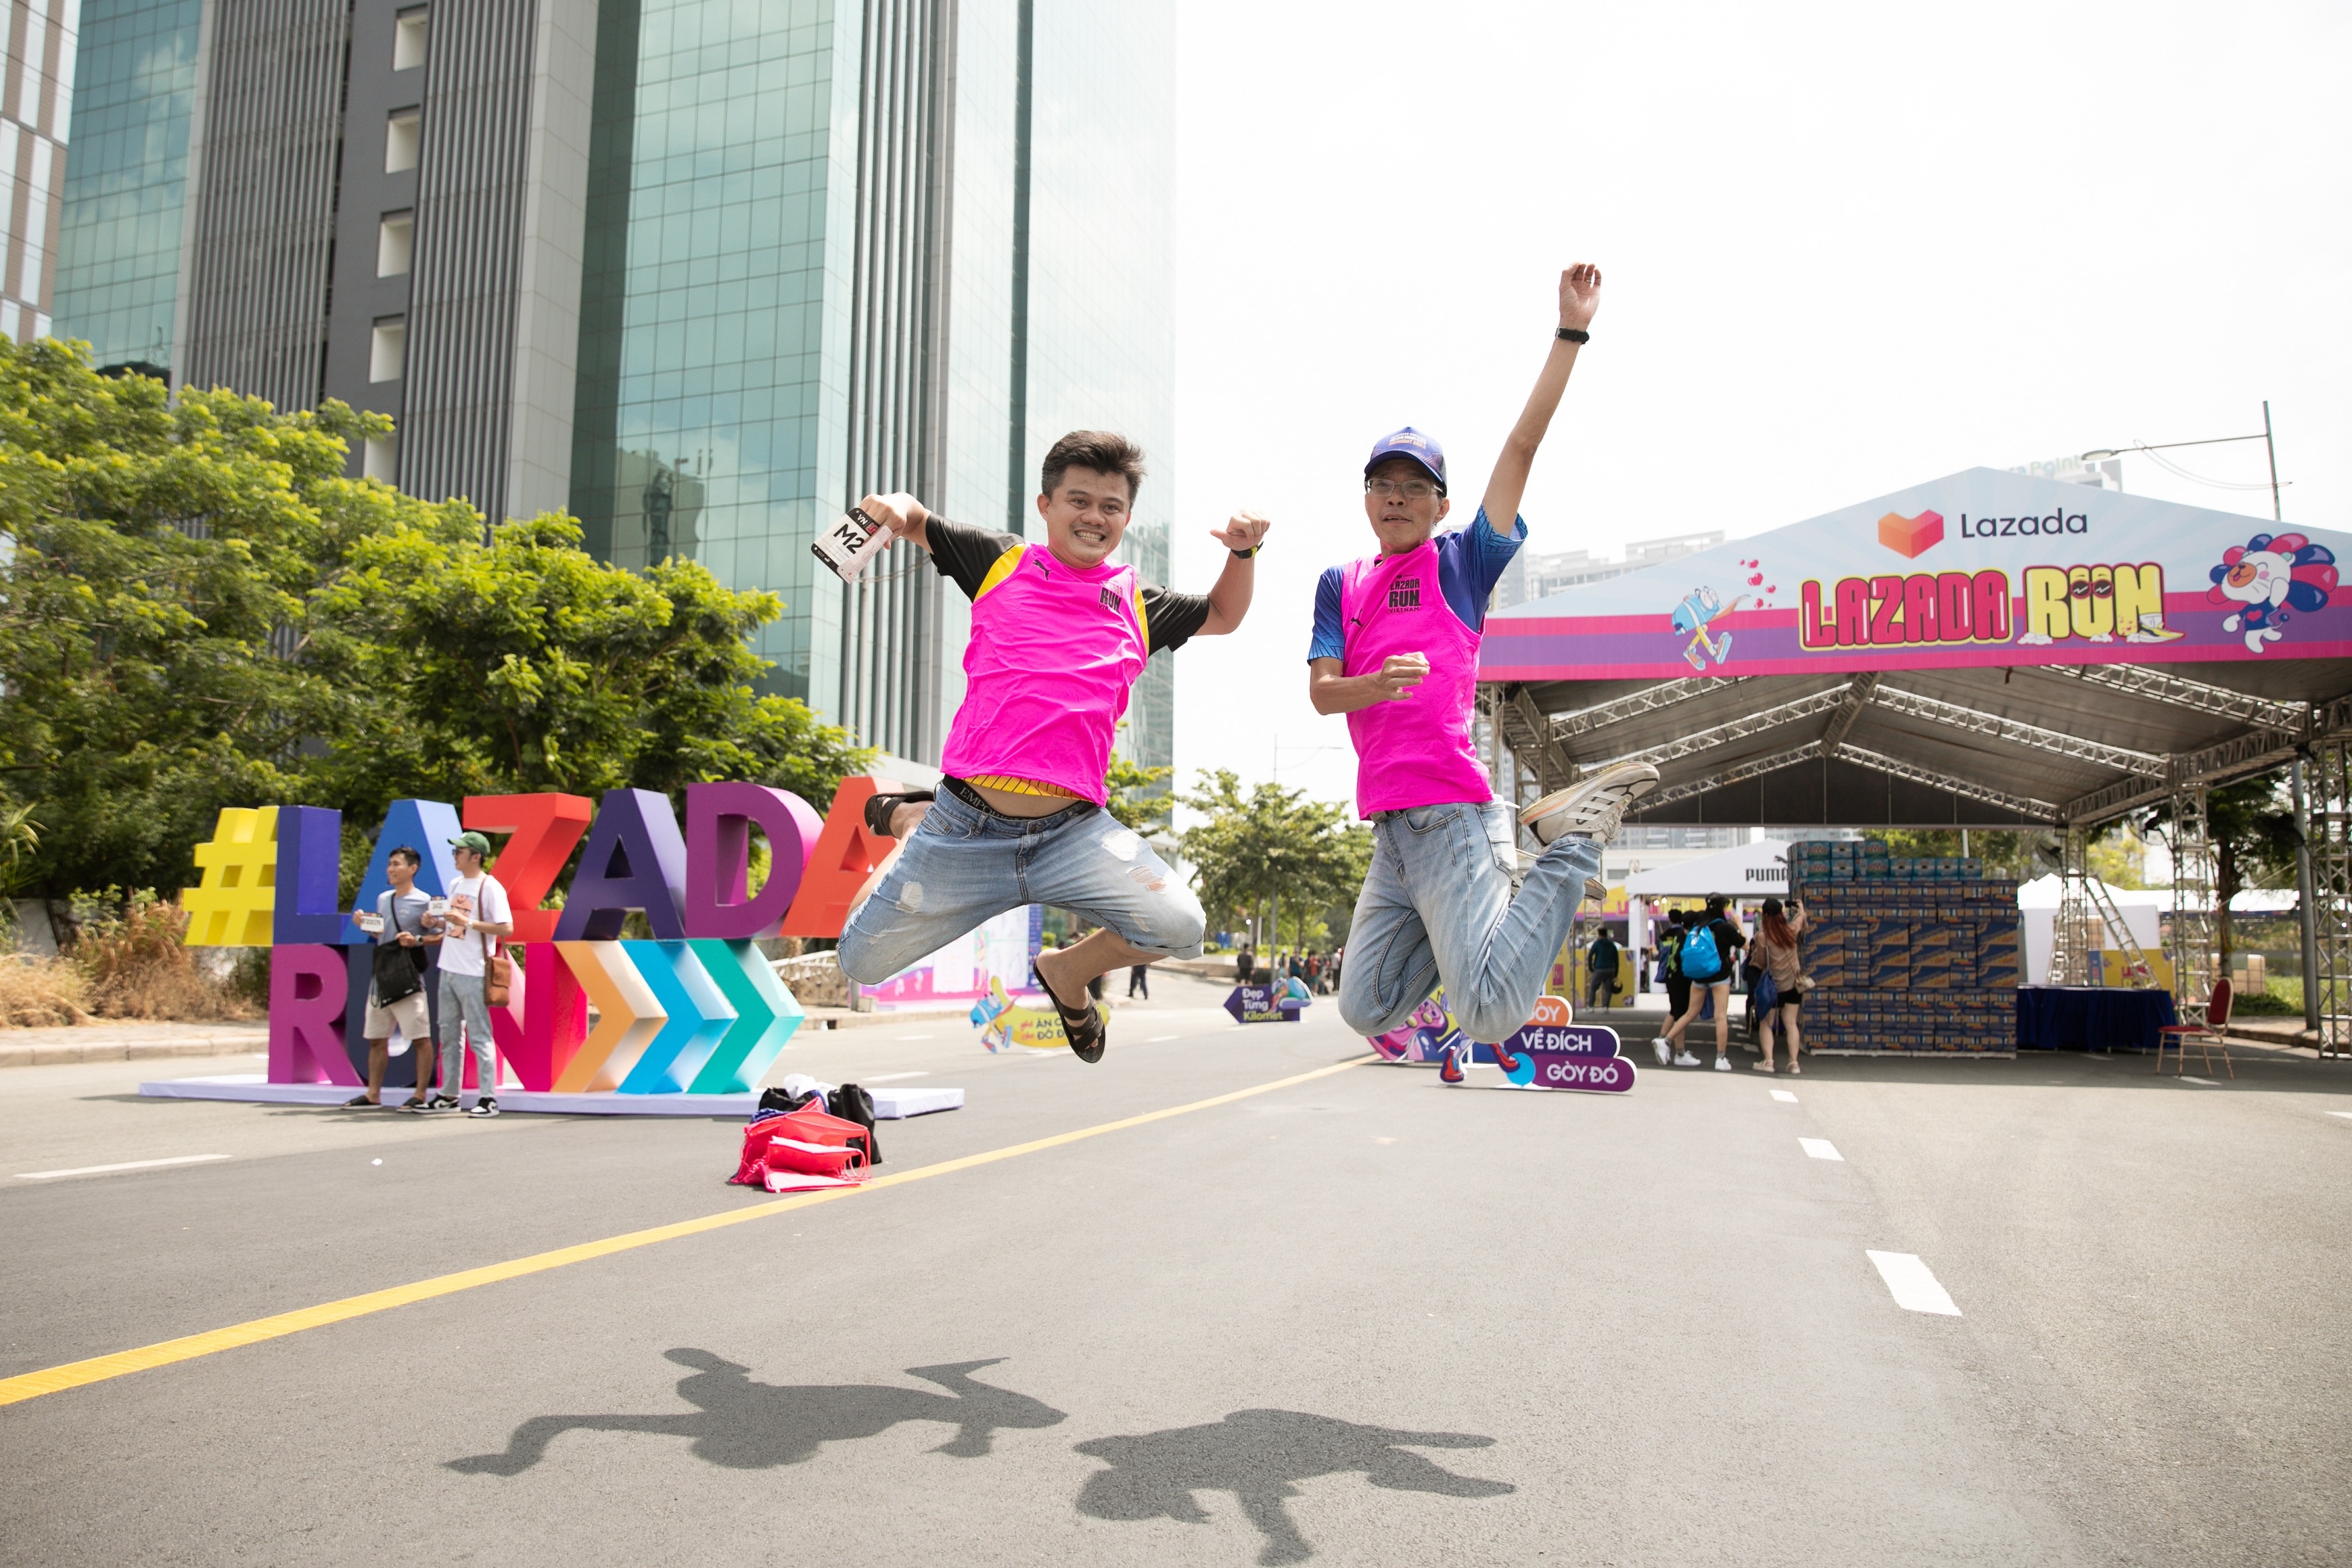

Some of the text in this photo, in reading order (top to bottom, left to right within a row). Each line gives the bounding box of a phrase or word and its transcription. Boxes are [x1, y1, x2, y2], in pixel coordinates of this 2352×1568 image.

[857, 514, 868, 525] VN
[1961, 508, 2088, 538] Lazada
[1390, 578, 1420, 591] LAZADA
[1100, 587, 1122, 612] RUN
[1389, 589, 1420, 607] RUN
[1800, 563, 2167, 651] LAZADA RUN
[1242, 988, 1264, 1000] Đẹp
[1521, 1027, 1592, 1052] VỀ ĐÍCH
[1546, 1061, 1619, 1084] GÒY ĐÓ
